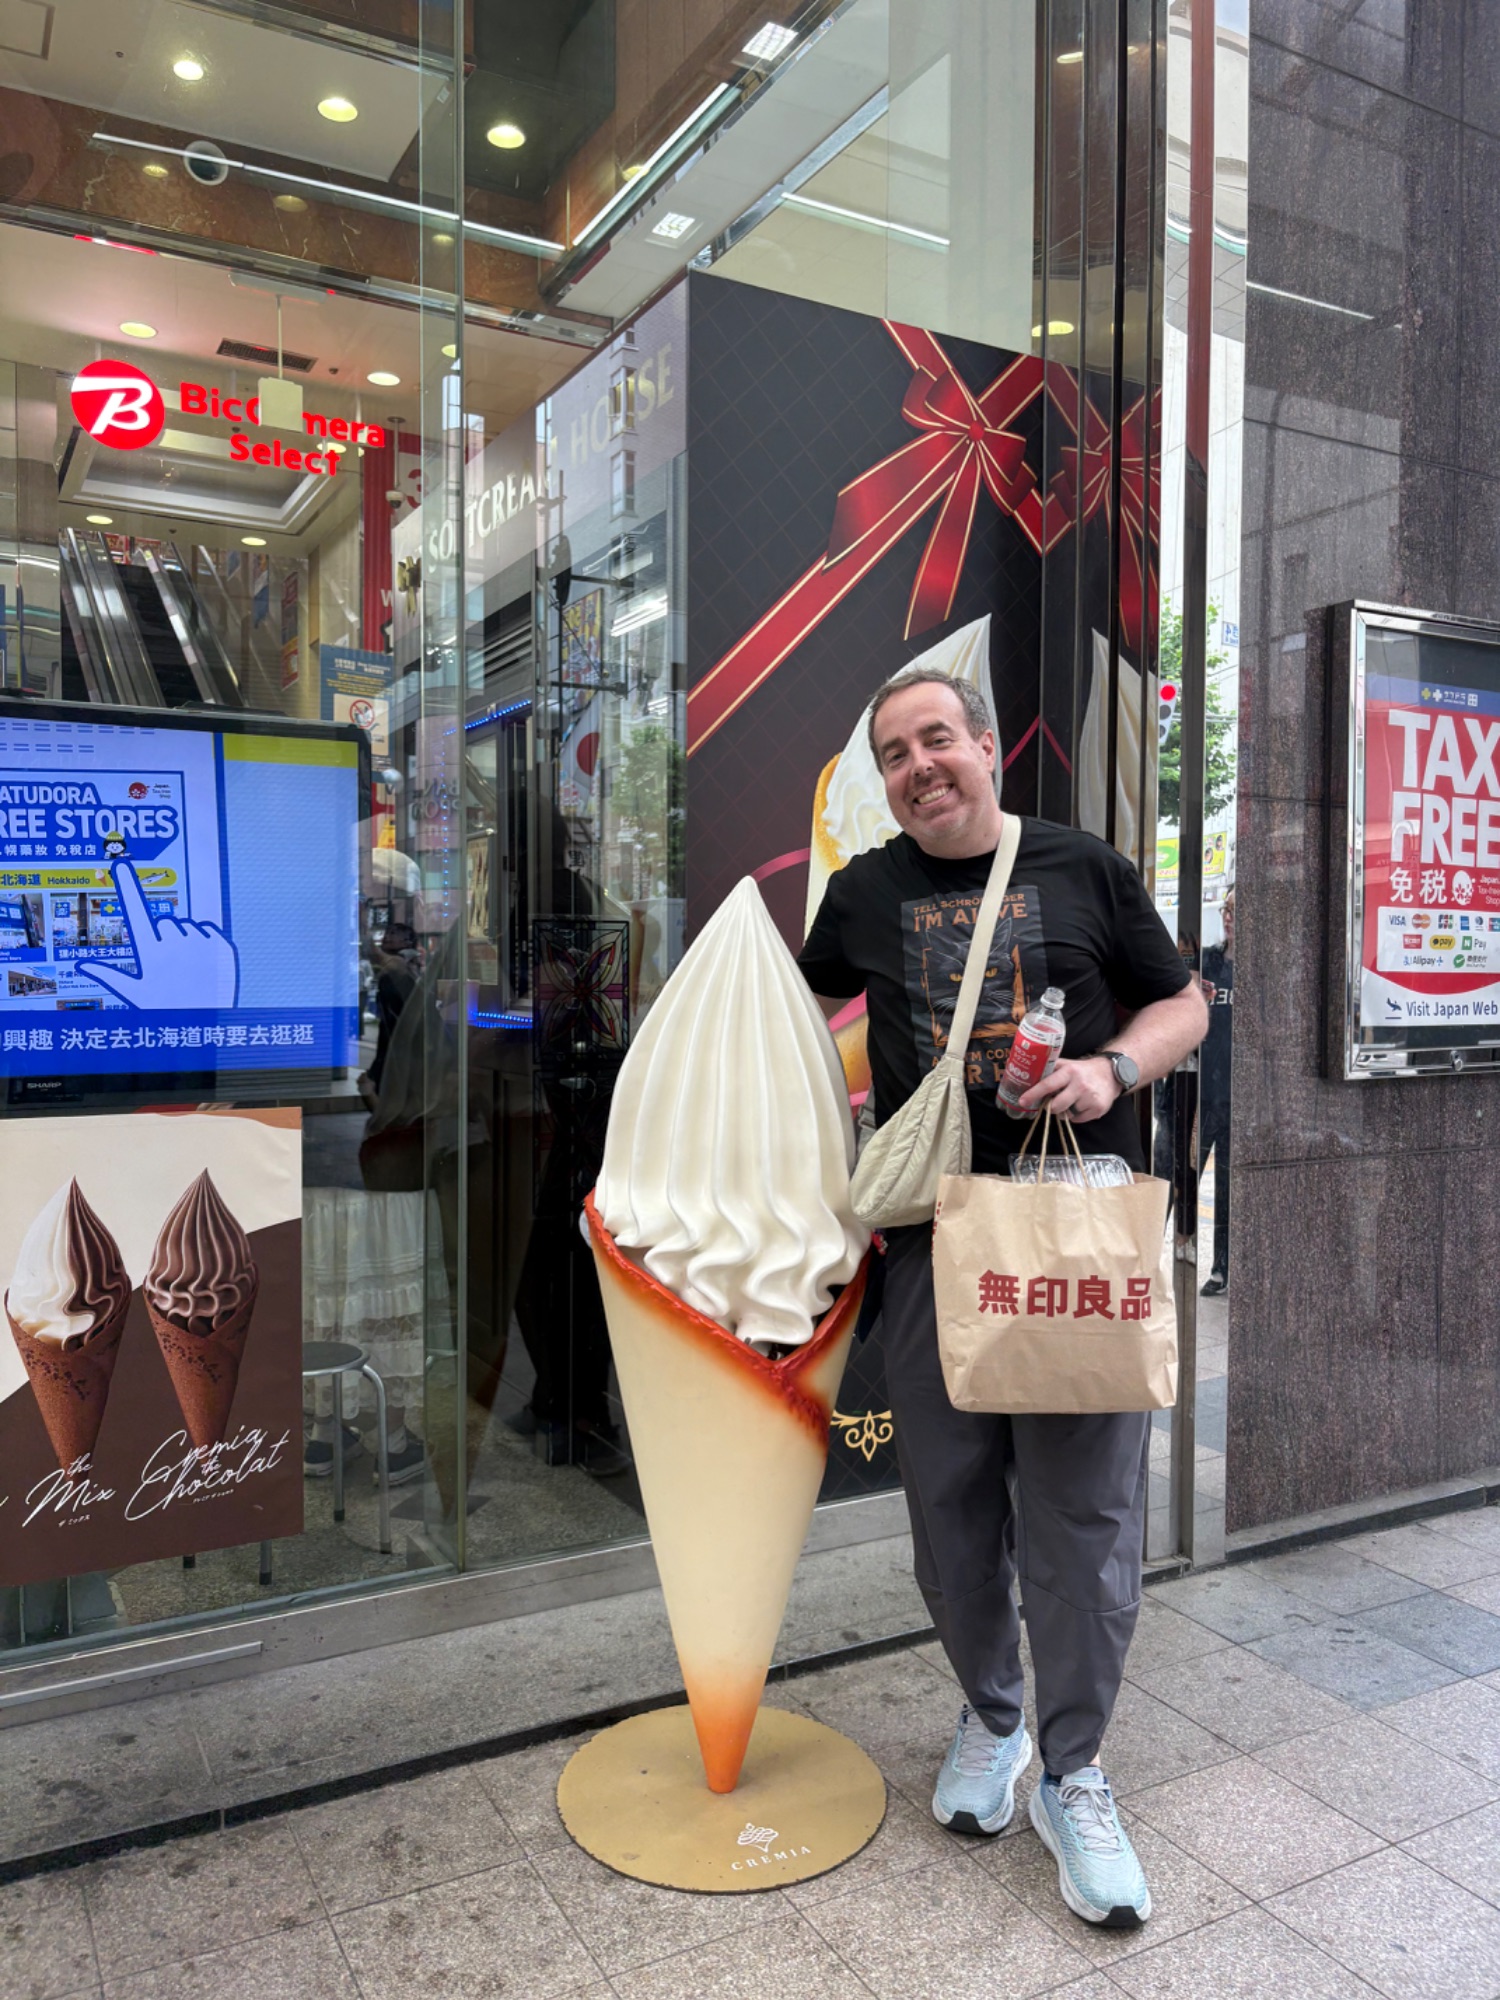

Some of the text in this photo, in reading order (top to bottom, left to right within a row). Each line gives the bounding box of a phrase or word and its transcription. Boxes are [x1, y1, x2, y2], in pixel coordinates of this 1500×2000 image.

[180, 382, 385, 448] BicCmera
[229, 433, 340, 476] Select
[1388, 708, 1500, 798] TAX
[0, 785, 97, 805] ATUDORA
[55, 809, 175, 839] STORES
[1390, 790, 1500, 869] FREE
[47, 876, 91, 885] Hokkaido
[913, 903, 938, 915] TELL
[914, 903, 1028, 933] I'M ALVE
[1389, 914, 1406, 927] VISA
[1474, 938, 1487, 950] Pay
[1413, 955, 1437, 967] Alipay
[1406, 1001, 1499, 1019] Visit Japan Web
[0, 1024, 315, 1051] 興趣 決定去北海道時要去逛逛
[27, 1082, 62, 1090] SHARP
[977, 1269, 1152, 1321] 無印良品
[67, 1452, 93, 1477] the
[124, 1429, 291, 1521] Chocolat
[22, 1467, 117, 1528] Mix
[730, 1845, 812, 1871] CREMIA
